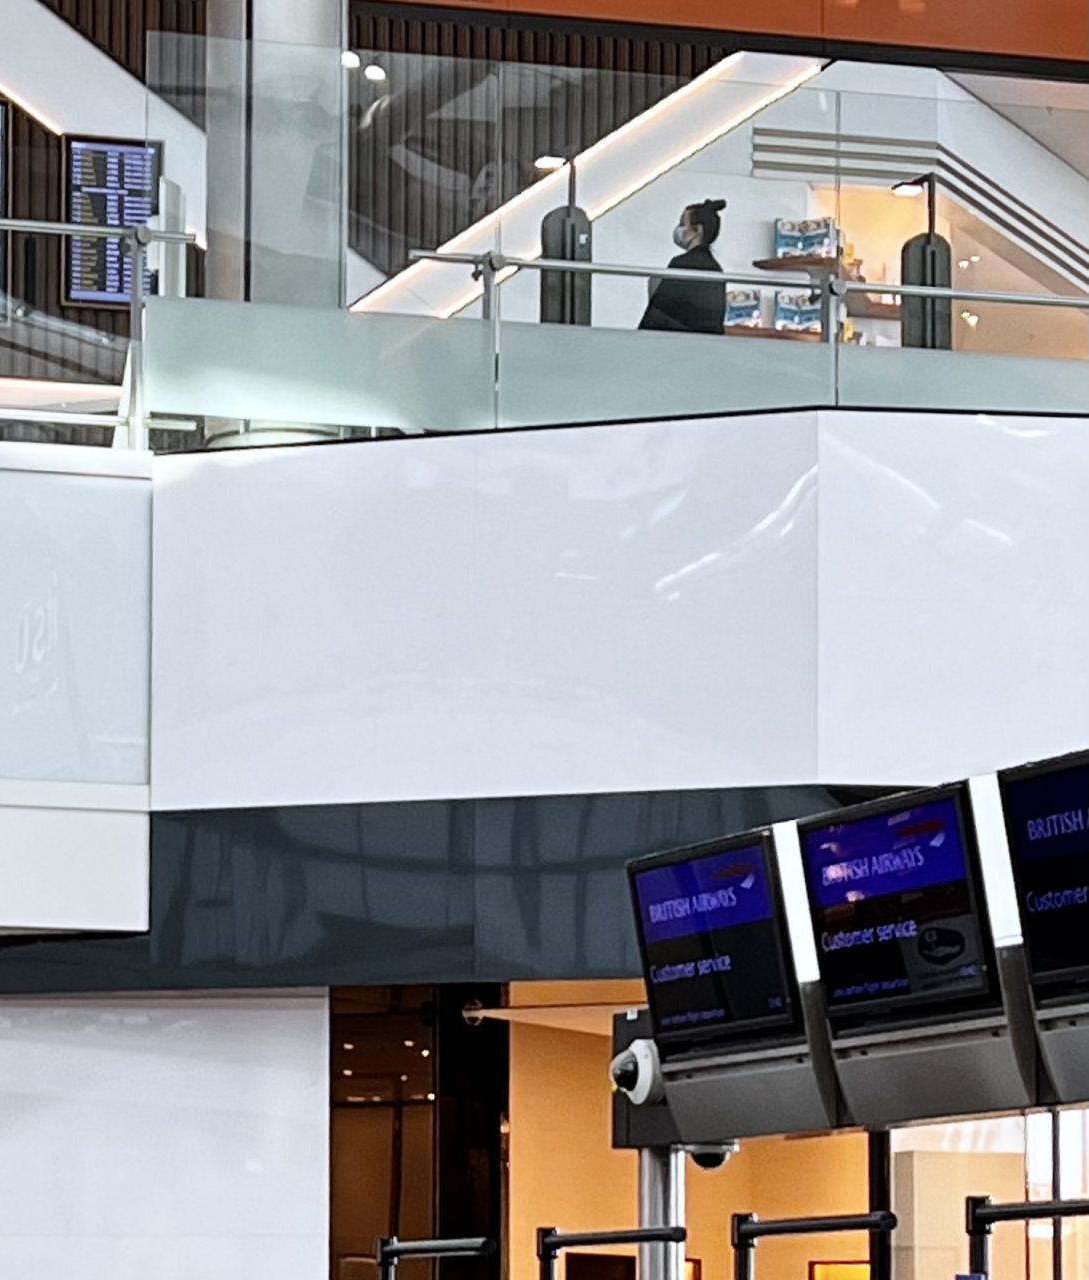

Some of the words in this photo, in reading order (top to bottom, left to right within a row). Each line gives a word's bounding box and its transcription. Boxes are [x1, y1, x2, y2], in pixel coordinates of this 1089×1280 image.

[1027, 809, 1084, 840] BRITISH
[1026, 886, 1088, 912] Customer
[821, 927, 874, 952] Customer
[876, 919, 918, 941] service
